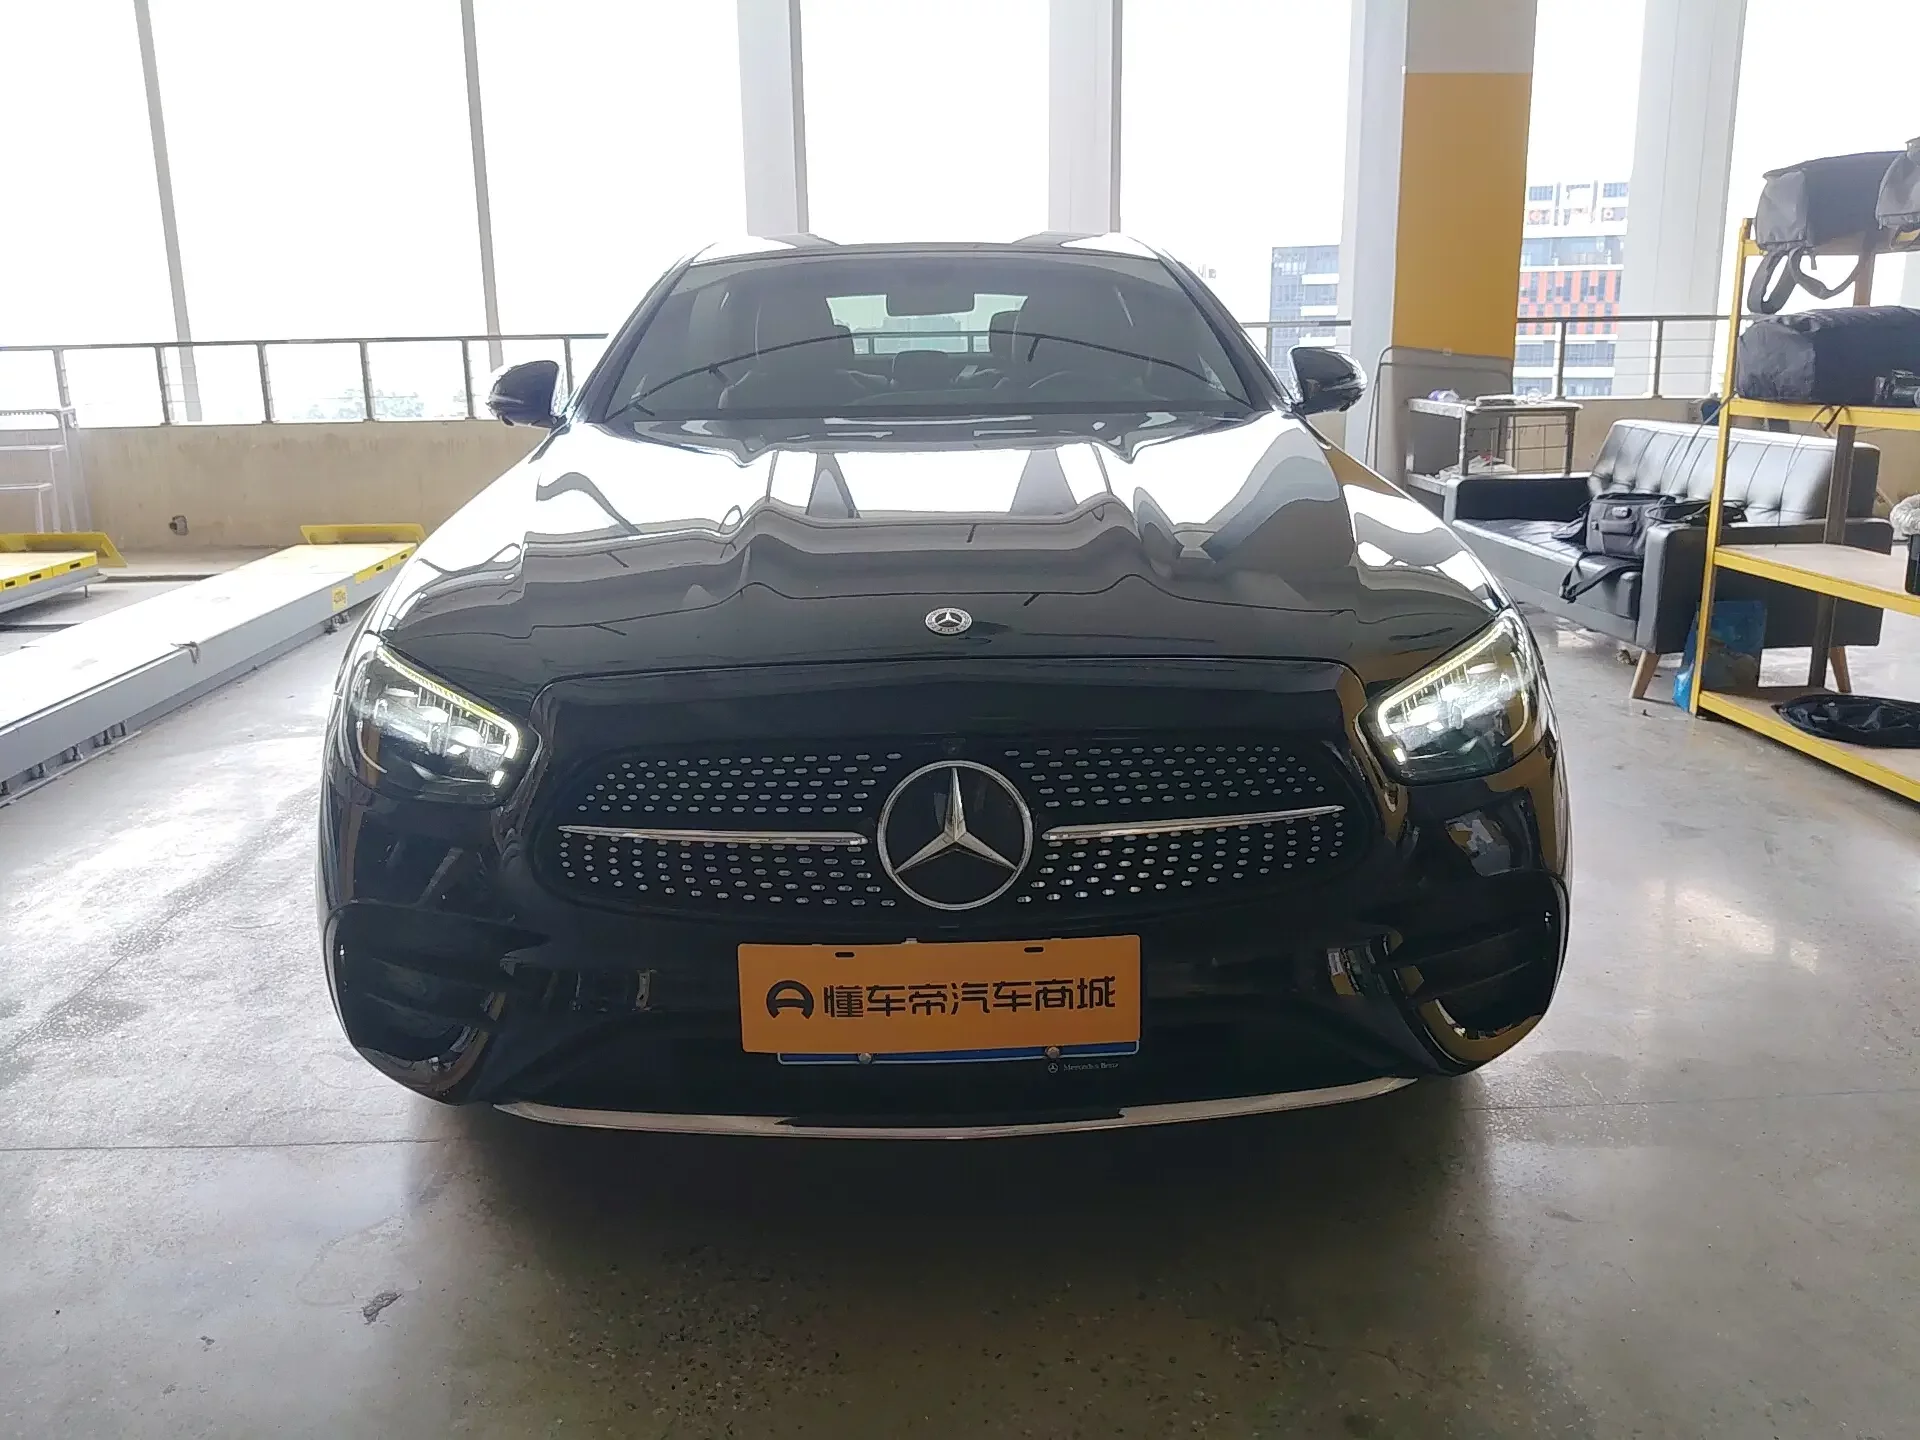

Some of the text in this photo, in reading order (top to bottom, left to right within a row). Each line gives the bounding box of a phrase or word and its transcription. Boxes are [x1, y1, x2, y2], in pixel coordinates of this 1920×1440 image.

[823, 976, 1116, 1018] 懂车帝汽车商城
